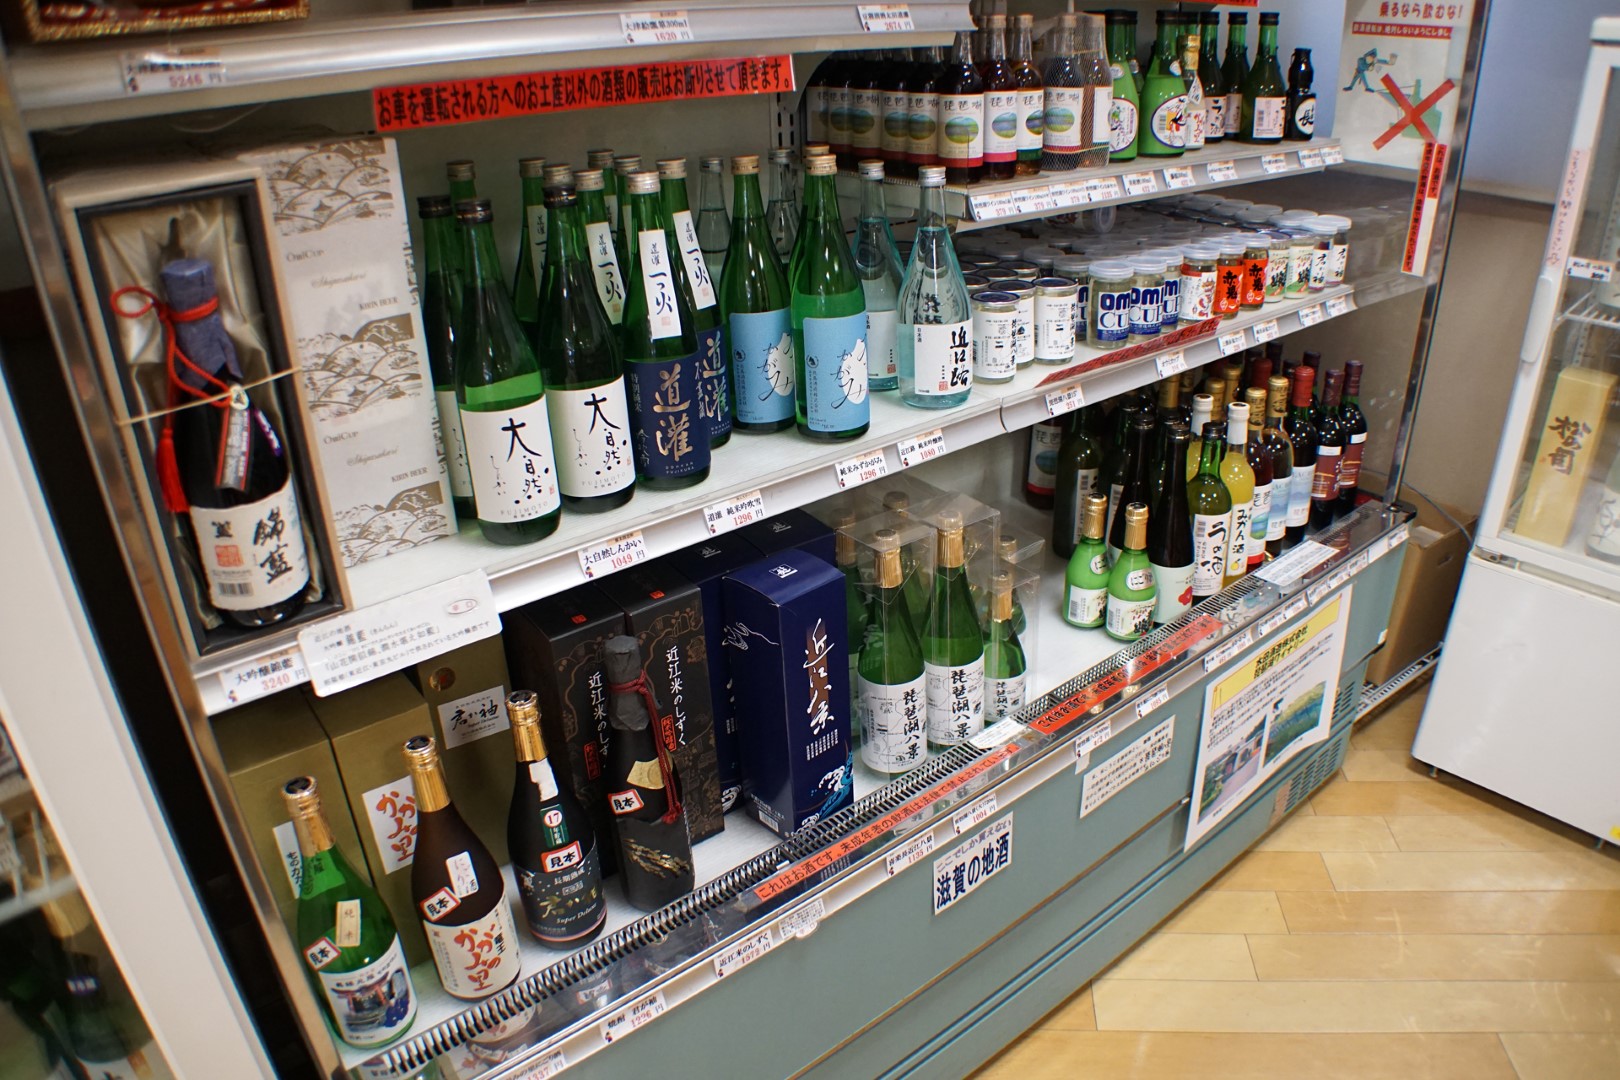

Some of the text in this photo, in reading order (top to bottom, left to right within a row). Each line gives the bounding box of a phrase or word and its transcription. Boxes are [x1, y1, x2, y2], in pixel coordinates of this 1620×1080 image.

[903, 21, 912, 30] 円
[654, 31, 690, 42] 1620 円
[208, 72, 223, 84] 円
[359, 296, 399, 311] KIRIN BEER
[652, 362, 695, 463] 道灌
[901, 444, 916, 456] 近江路
[937, 444, 945, 454] 円
[1548, 414, 1594, 475] 松の司
[391, 466, 428, 483] KIRIN BEER
[839, 455, 883, 476] 純米みずかがみ
[859, 465, 887, 482] 1296 円
[581, 472, 626, 486] FUJIMOTO
[500, 501, 549, 516] FUJIMOTO
[707, 510, 722, 524] 道灌
[733, 507, 764, 527] 1296 円
[1232, 509, 1248, 554] みかん酒
[583, 537, 643, 566] 大自然しんかい
[611, 550, 646, 571] 1049 円
[261, 667, 307, 691] 3240 円
[665, 645, 687, 746] 近江米のしずく
[950, 668, 971, 739] 琵琶湖八景
[588, 671, 610, 768] 近江米のしず
[903, 687, 920, 760] 琵琶湖八景
[613, 796, 635, 811] 見本
[989, 805, 997, 814] 円
[547, 812, 560, 825] 17
[550, 850, 577, 869] 見本
[907, 844, 933, 865] 1135 円
[936, 831, 1010, 910] 滋賀の地酒
[426, 896, 451, 917] 見本
[556, 902, 597, 924] Super Deluxe
[309, 946, 330, 966] 見本
[719, 933, 770, 969] 近江米のしずく
[740, 940, 771, 965] 1572 円
[607, 995, 658, 1031] 焼酎 君が袖
[630, 1002, 665, 1029] 1226 円
[554, 1058, 565, 1072] 円
